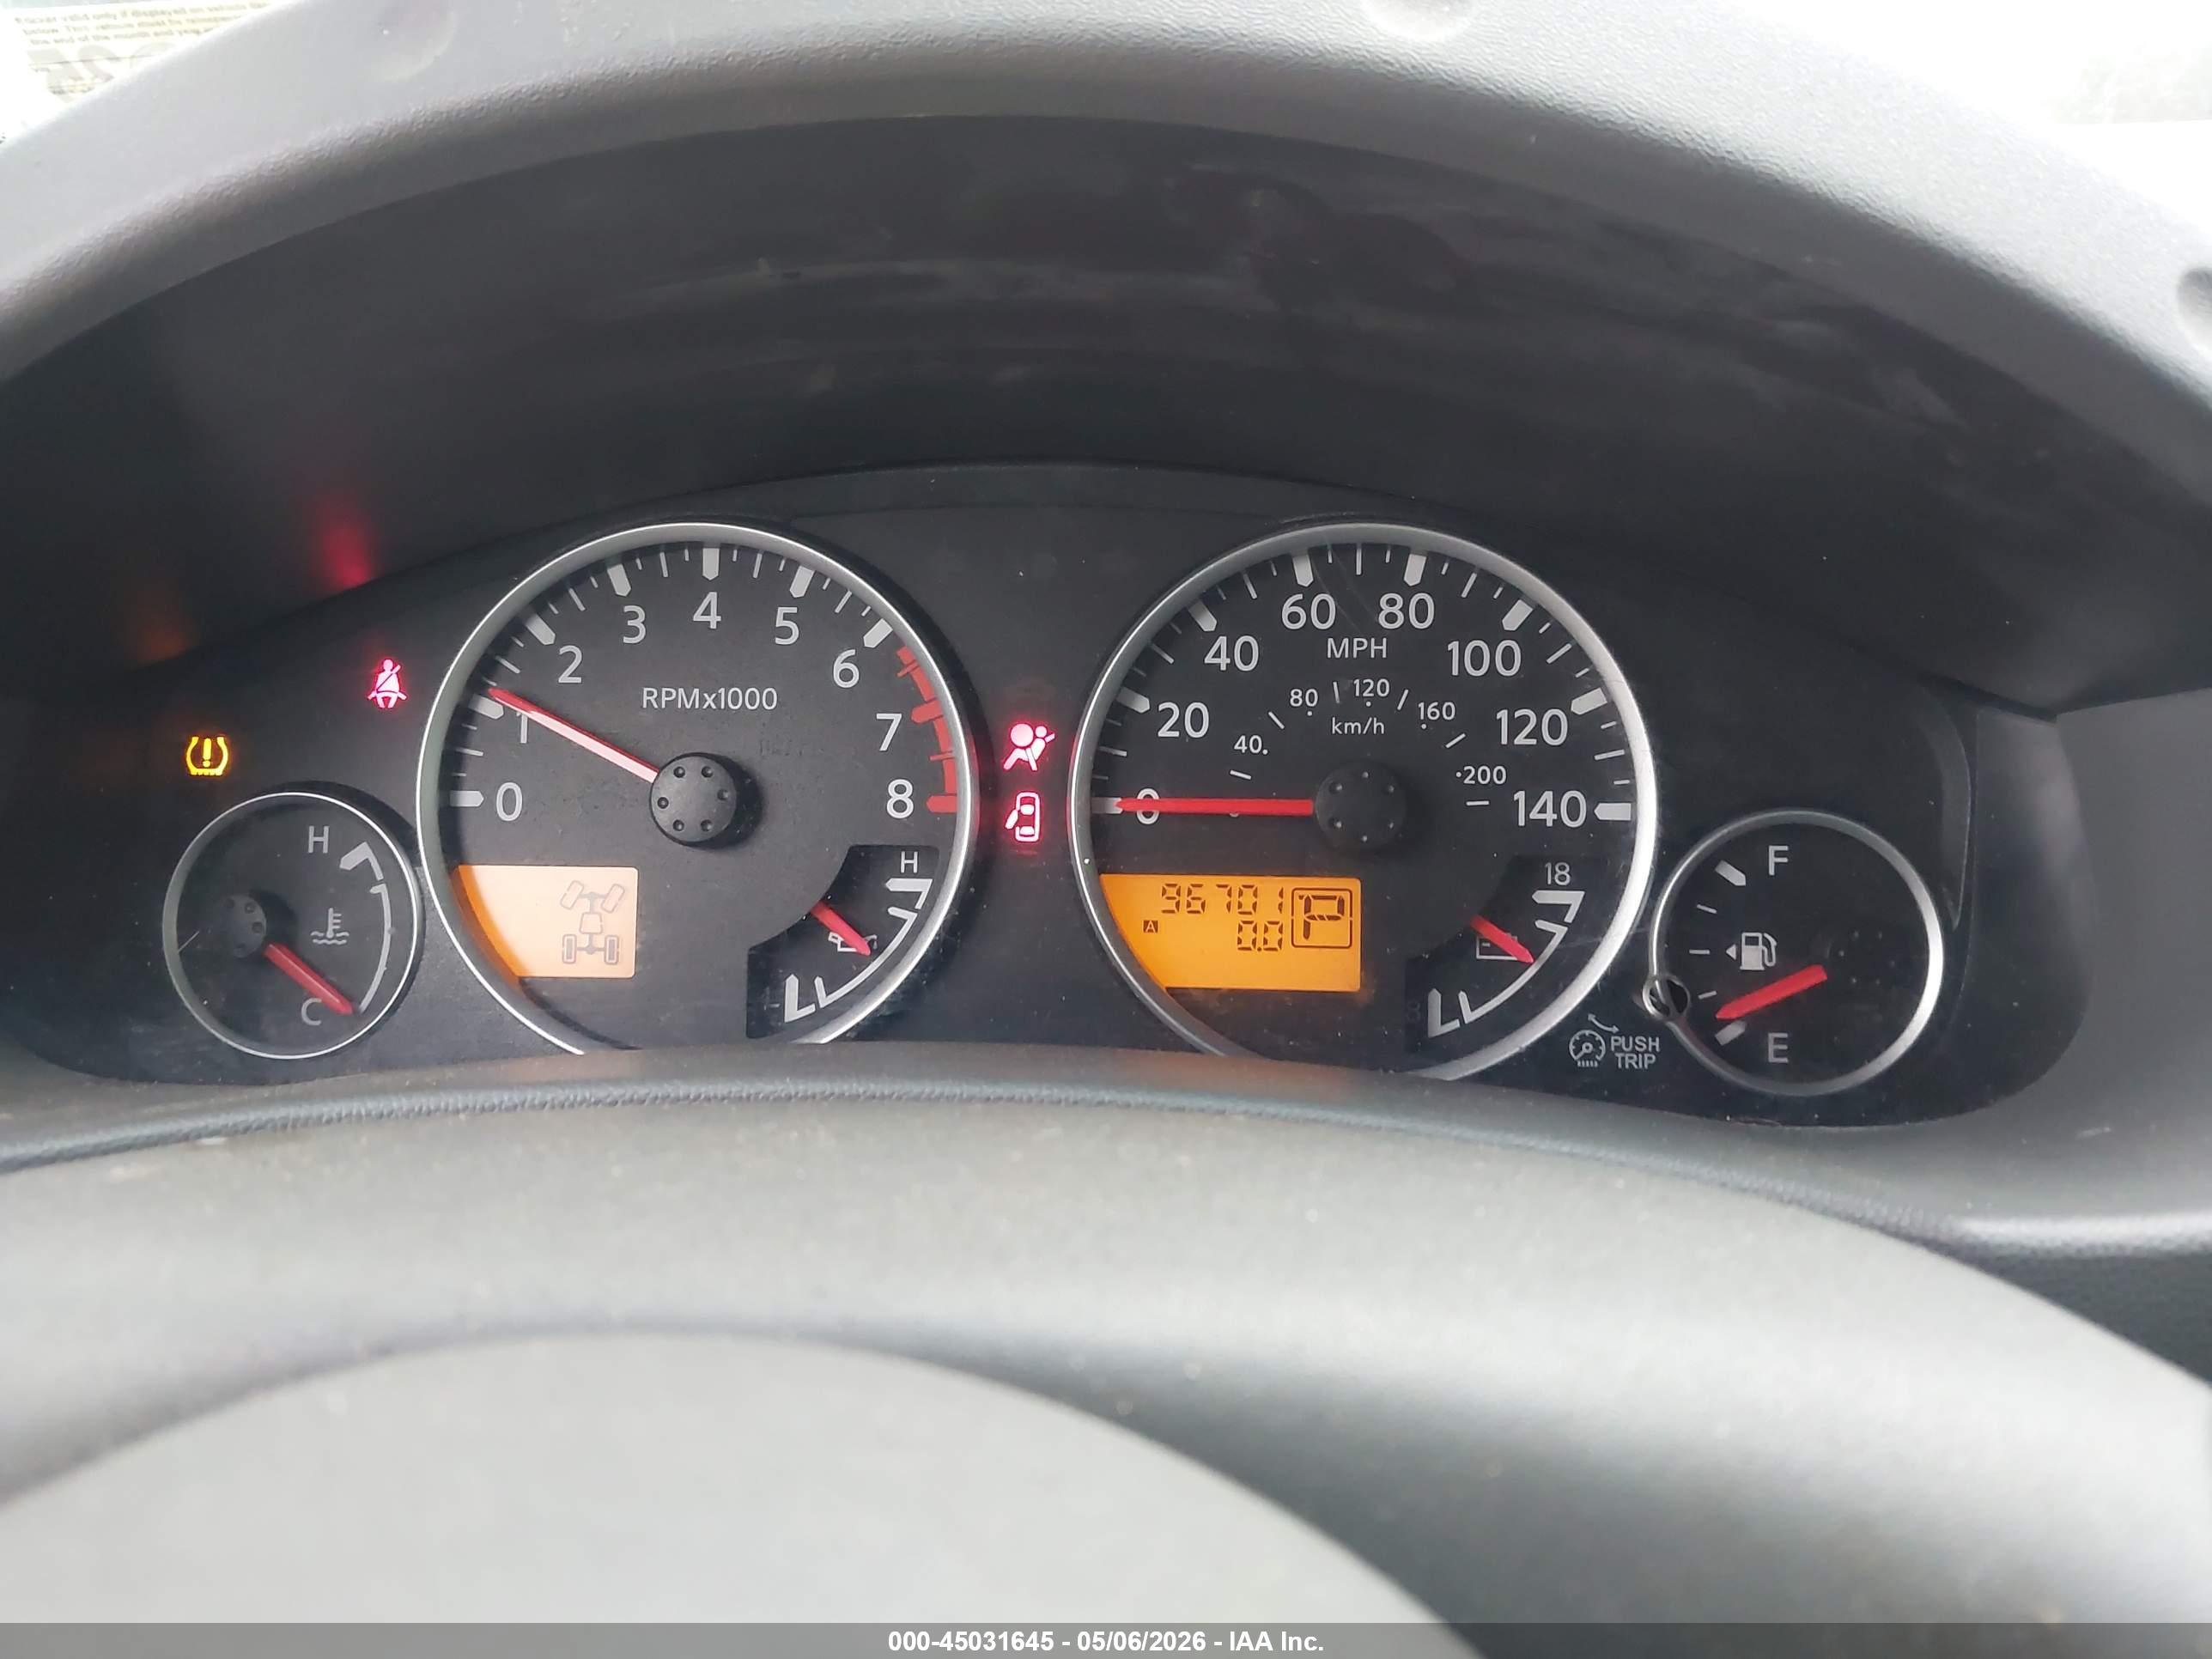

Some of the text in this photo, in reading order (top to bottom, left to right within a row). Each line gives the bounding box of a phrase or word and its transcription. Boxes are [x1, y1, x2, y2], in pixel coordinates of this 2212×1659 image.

[623, 605, 646, 644] 3
[692, 592, 722, 629] 4
[775, 606, 799, 645] 5
[1281, 593, 1336, 629] 60
[1378, 592, 1435, 629] 80
[1204, 635, 1259, 672] 40
[1327, 637, 1387, 659] MPH
[1447, 640, 1522, 677] 100
[557, 645, 582, 684] 2
[833, 649, 860, 689] 6
[642, 687, 778, 710] RPMx1000
[1290, 688, 1318, 707] 80
[1353, 678, 1390, 697] 120
[1158, 702, 1209, 738] 20
[1332, 716, 1385, 734] km/h
[1418, 702, 1455, 720] 160
[1496, 708, 1568, 746] 120
[516, 711, 532, 744] 1
[876, 713, 902, 751] 7
[1463, 765, 1507, 785] 200
[495, 781, 523, 822] 0
[886, 779, 914, 819] 8
[1135, 787, 1160, 826] 0
[1513, 790, 1587, 828] 140
[307, 825, 330, 854] H
[900, 851, 918, 873] H
[1545, 862, 1571, 886] 18
[1768, 845, 1789, 876] F
[1161, 884, 1284, 915] 96701
[1143, 920, 1158, 933] A
[1299, 894, 1346, 940] P
[1237, 920, 1283, 951] 0.0
[301, 998, 322, 1026] C
[1610, 1036, 1660, 1055] PUSH
[1614, 1052, 1656, 1069] TRIP
[1767, 1032, 1789, 1063] E
